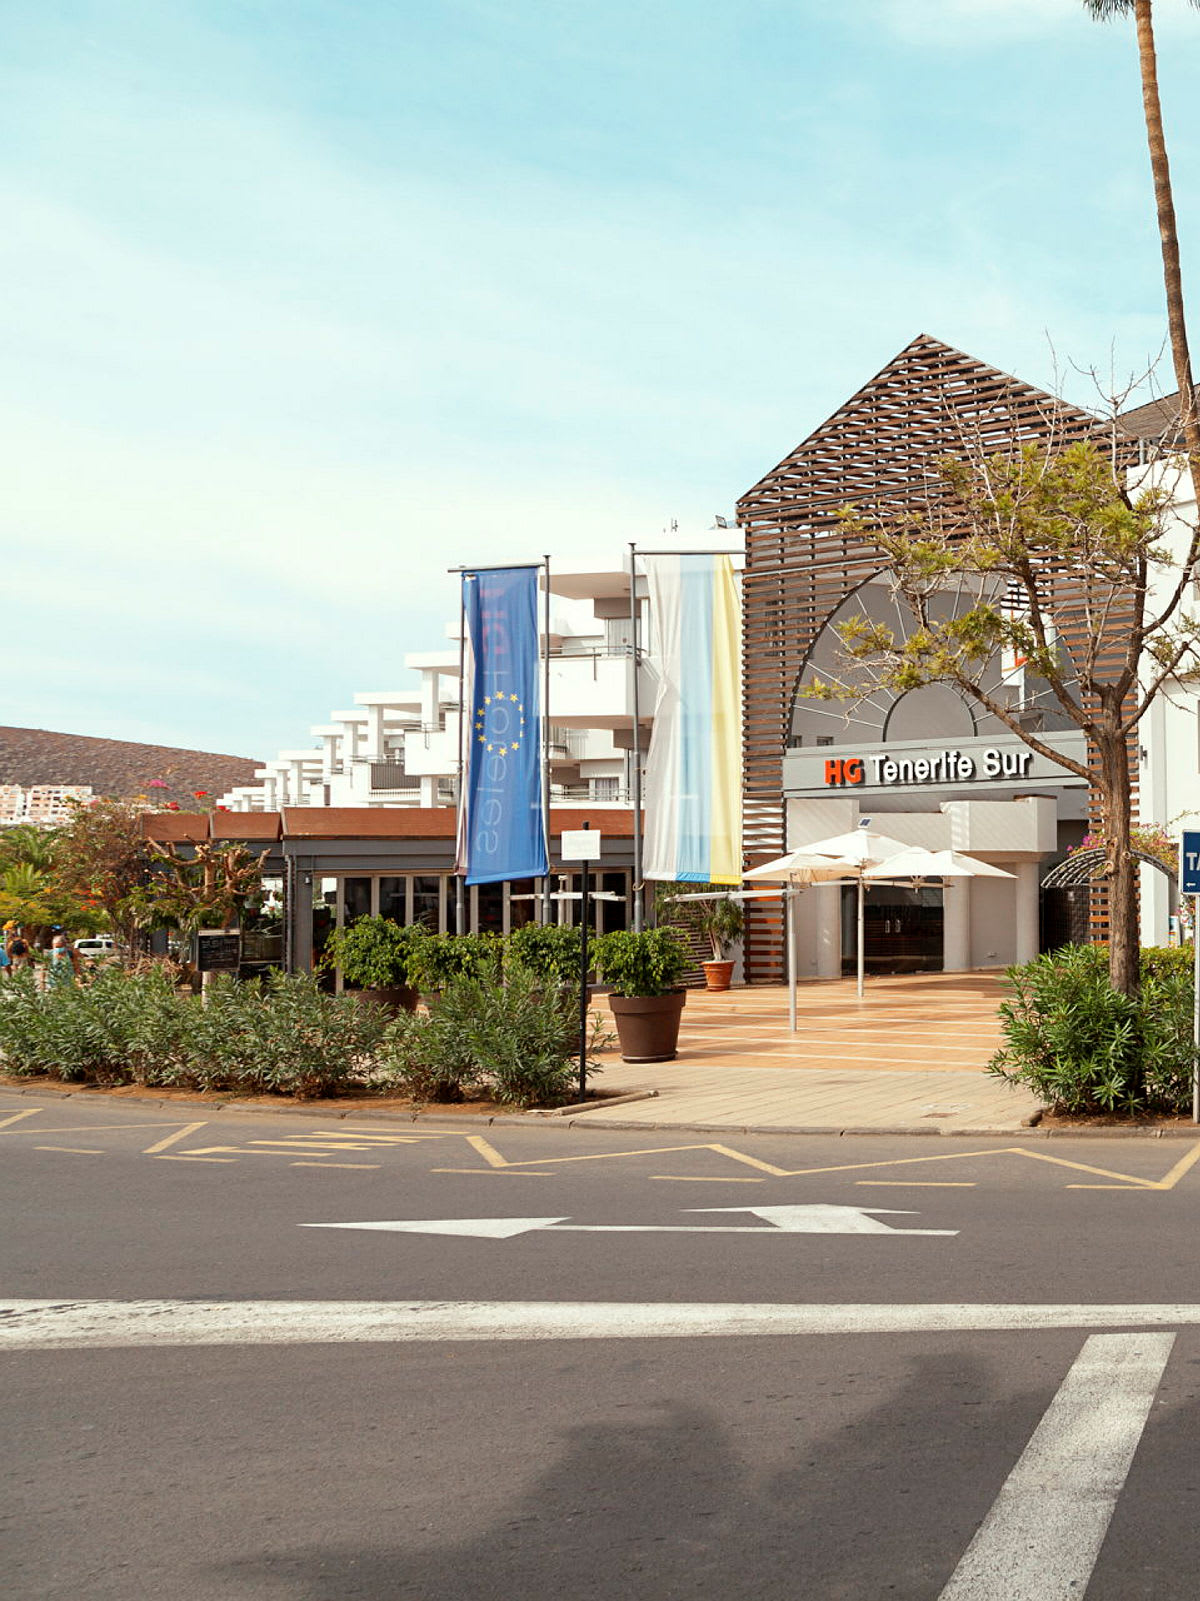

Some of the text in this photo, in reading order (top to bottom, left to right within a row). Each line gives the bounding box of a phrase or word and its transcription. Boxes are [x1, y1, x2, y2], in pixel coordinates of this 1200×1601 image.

[825, 749, 1032, 785] HG Tenerife Sur
